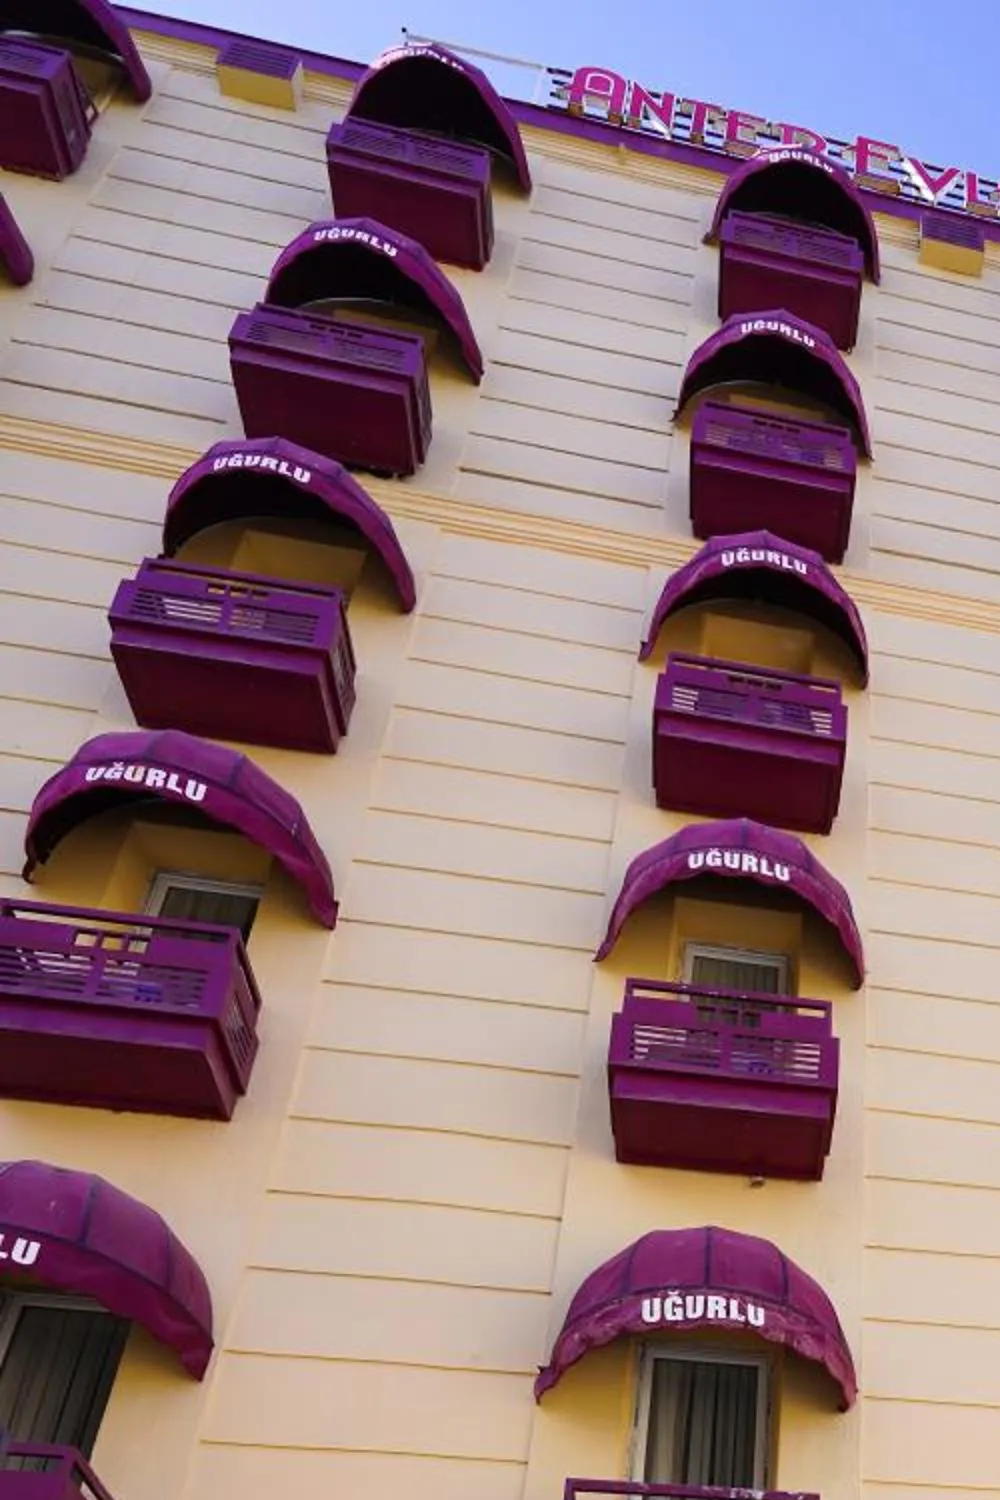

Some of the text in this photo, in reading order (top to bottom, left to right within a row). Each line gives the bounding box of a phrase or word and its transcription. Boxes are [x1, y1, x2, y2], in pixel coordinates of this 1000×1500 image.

[213, 453, 311, 483] UĞURLU
[721, 547, 808, 575] UĞURLU
[85, 761, 208, 801] UĞURLU
[687, 848, 791, 882] UĞURLU
[641, 1291, 766, 1327] UĞURLU
